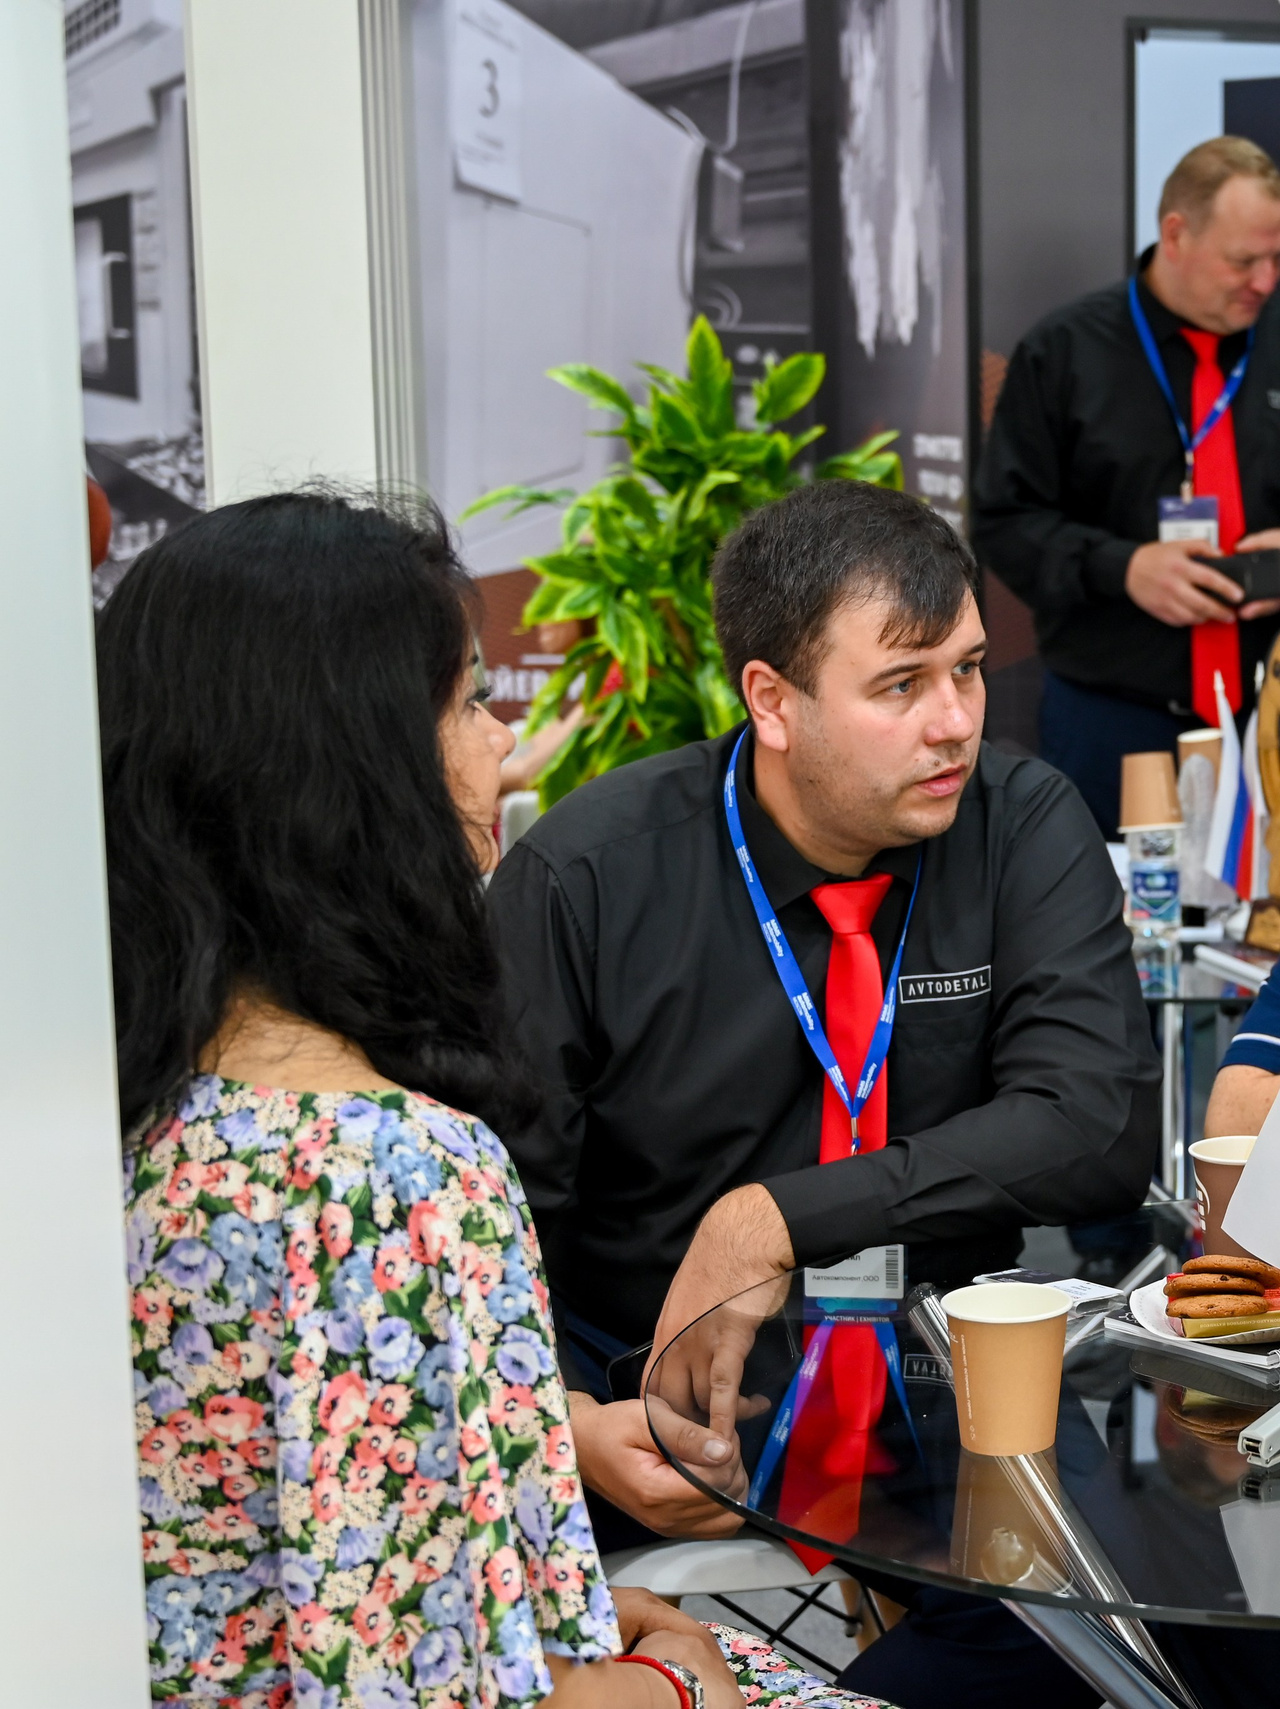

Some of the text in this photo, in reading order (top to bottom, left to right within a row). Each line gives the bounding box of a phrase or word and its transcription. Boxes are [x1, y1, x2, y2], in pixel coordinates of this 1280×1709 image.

[479, 58, 500, 119] 3
[908, 974, 987, 997] AVTODETAL
[824, 1315, 855, 1323] УЧАСТНИК
